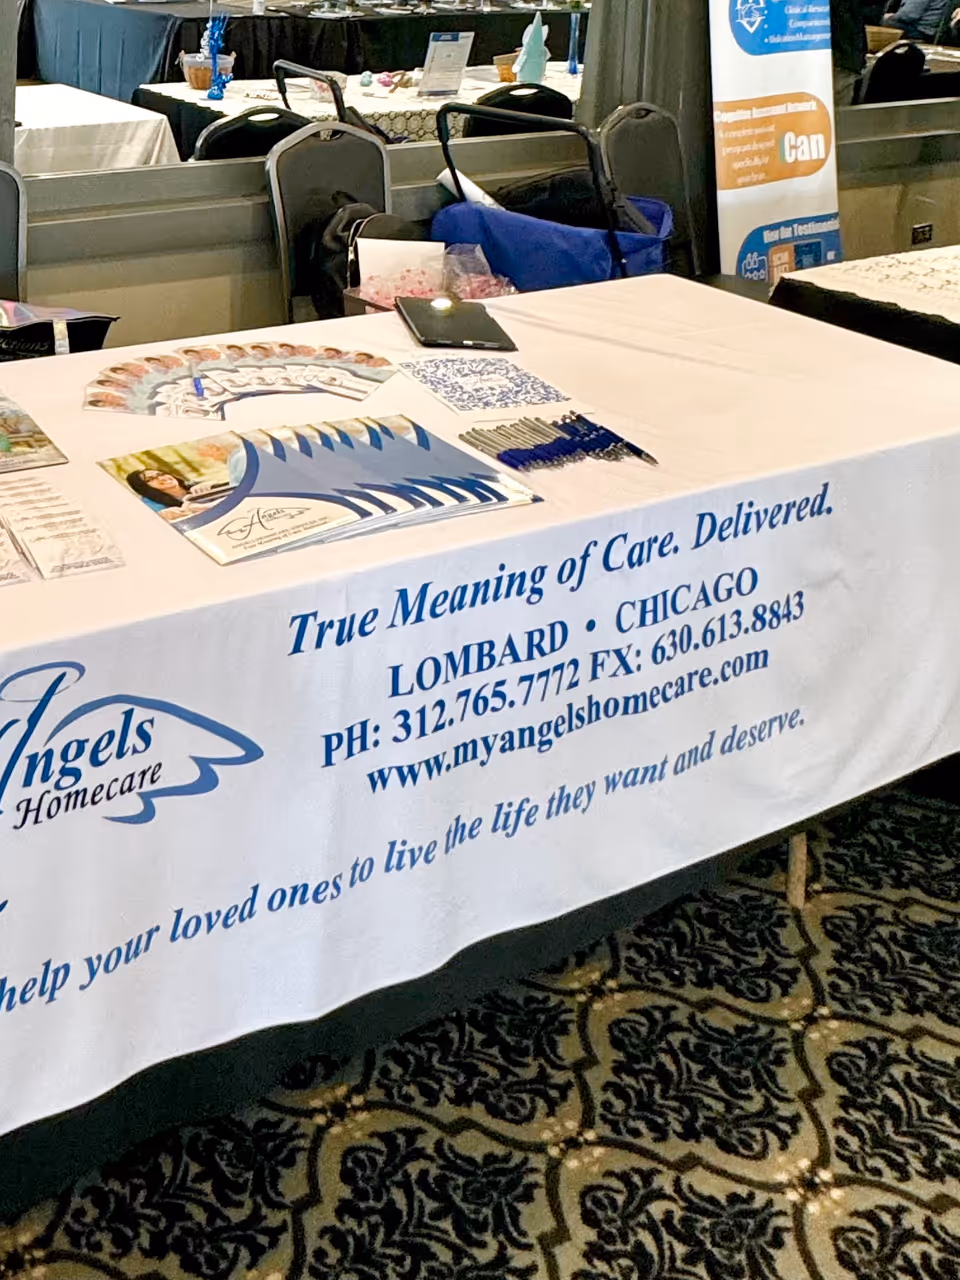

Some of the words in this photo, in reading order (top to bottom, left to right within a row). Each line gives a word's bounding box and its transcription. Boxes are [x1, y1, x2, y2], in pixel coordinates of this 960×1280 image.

[784, 131, 825, 163] Can
[286, 606, 379, 657] True
[386, 562, 547, 630] Meaning
[556, 540, 599, 590] of
[601, 532, 680, 574] Care.
[691, 481, 834, 552] Delivered.
[388, 619, 569, 699] LOMBARD
[615, 566, 758, 635] CHICAGO
[321, 723, 380, 767] PH:
[391, 658, 581, 746] 312.765.7772
[588, 642, 643, 682] FX:
[650, 590, 806, 665] 630.613.8843
[366, 646, 770, 794] www.myangelshomecare.com
[13, 761, 164, 831] Homecare
[79, 924, 161, 993] your
[168, 884, 259, 944] loved
[266, 871, 344, 911] ones
[349, 855, 377, 884] to
[385, 835, 438, 874] live
[444, 812, 484, 855] the
[490, 798, 541, 839] life
[545, 777, 598, 822] they
[603, 752, 669, 796] want
[673, 732, 716, 776] and
[720, 703, 806, 757] deserve.
